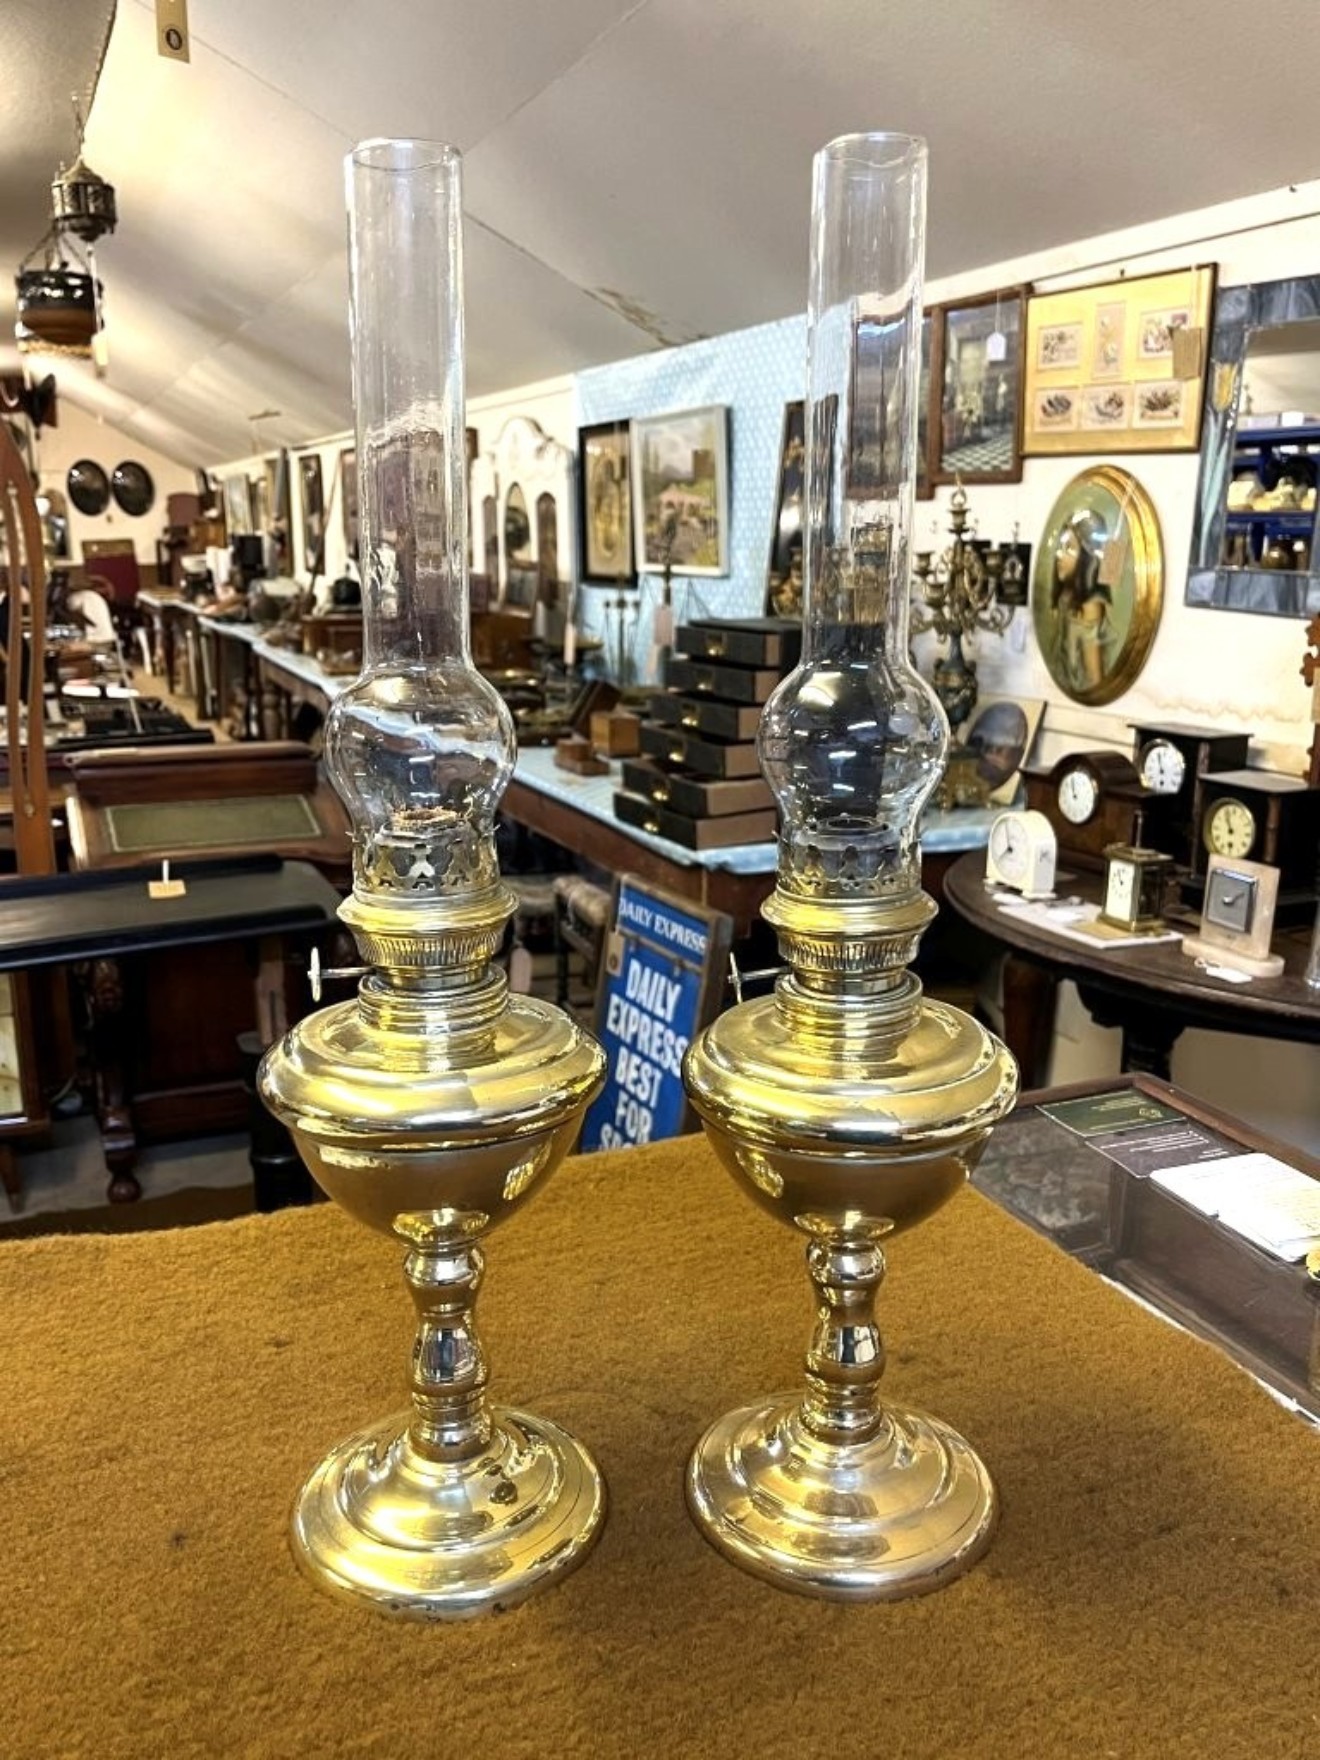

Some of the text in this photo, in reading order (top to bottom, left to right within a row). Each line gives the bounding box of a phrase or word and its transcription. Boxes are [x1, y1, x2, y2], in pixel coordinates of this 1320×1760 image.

[619, 897, 706, 955] DAILY EXPRESS
[626, 958, 682, 1022] DAILY
[606, 993, 689, 1079] EXPRESS
[615, 1046, 663, 1109] BEST
[615, 1089, 652, 1144] FOR
